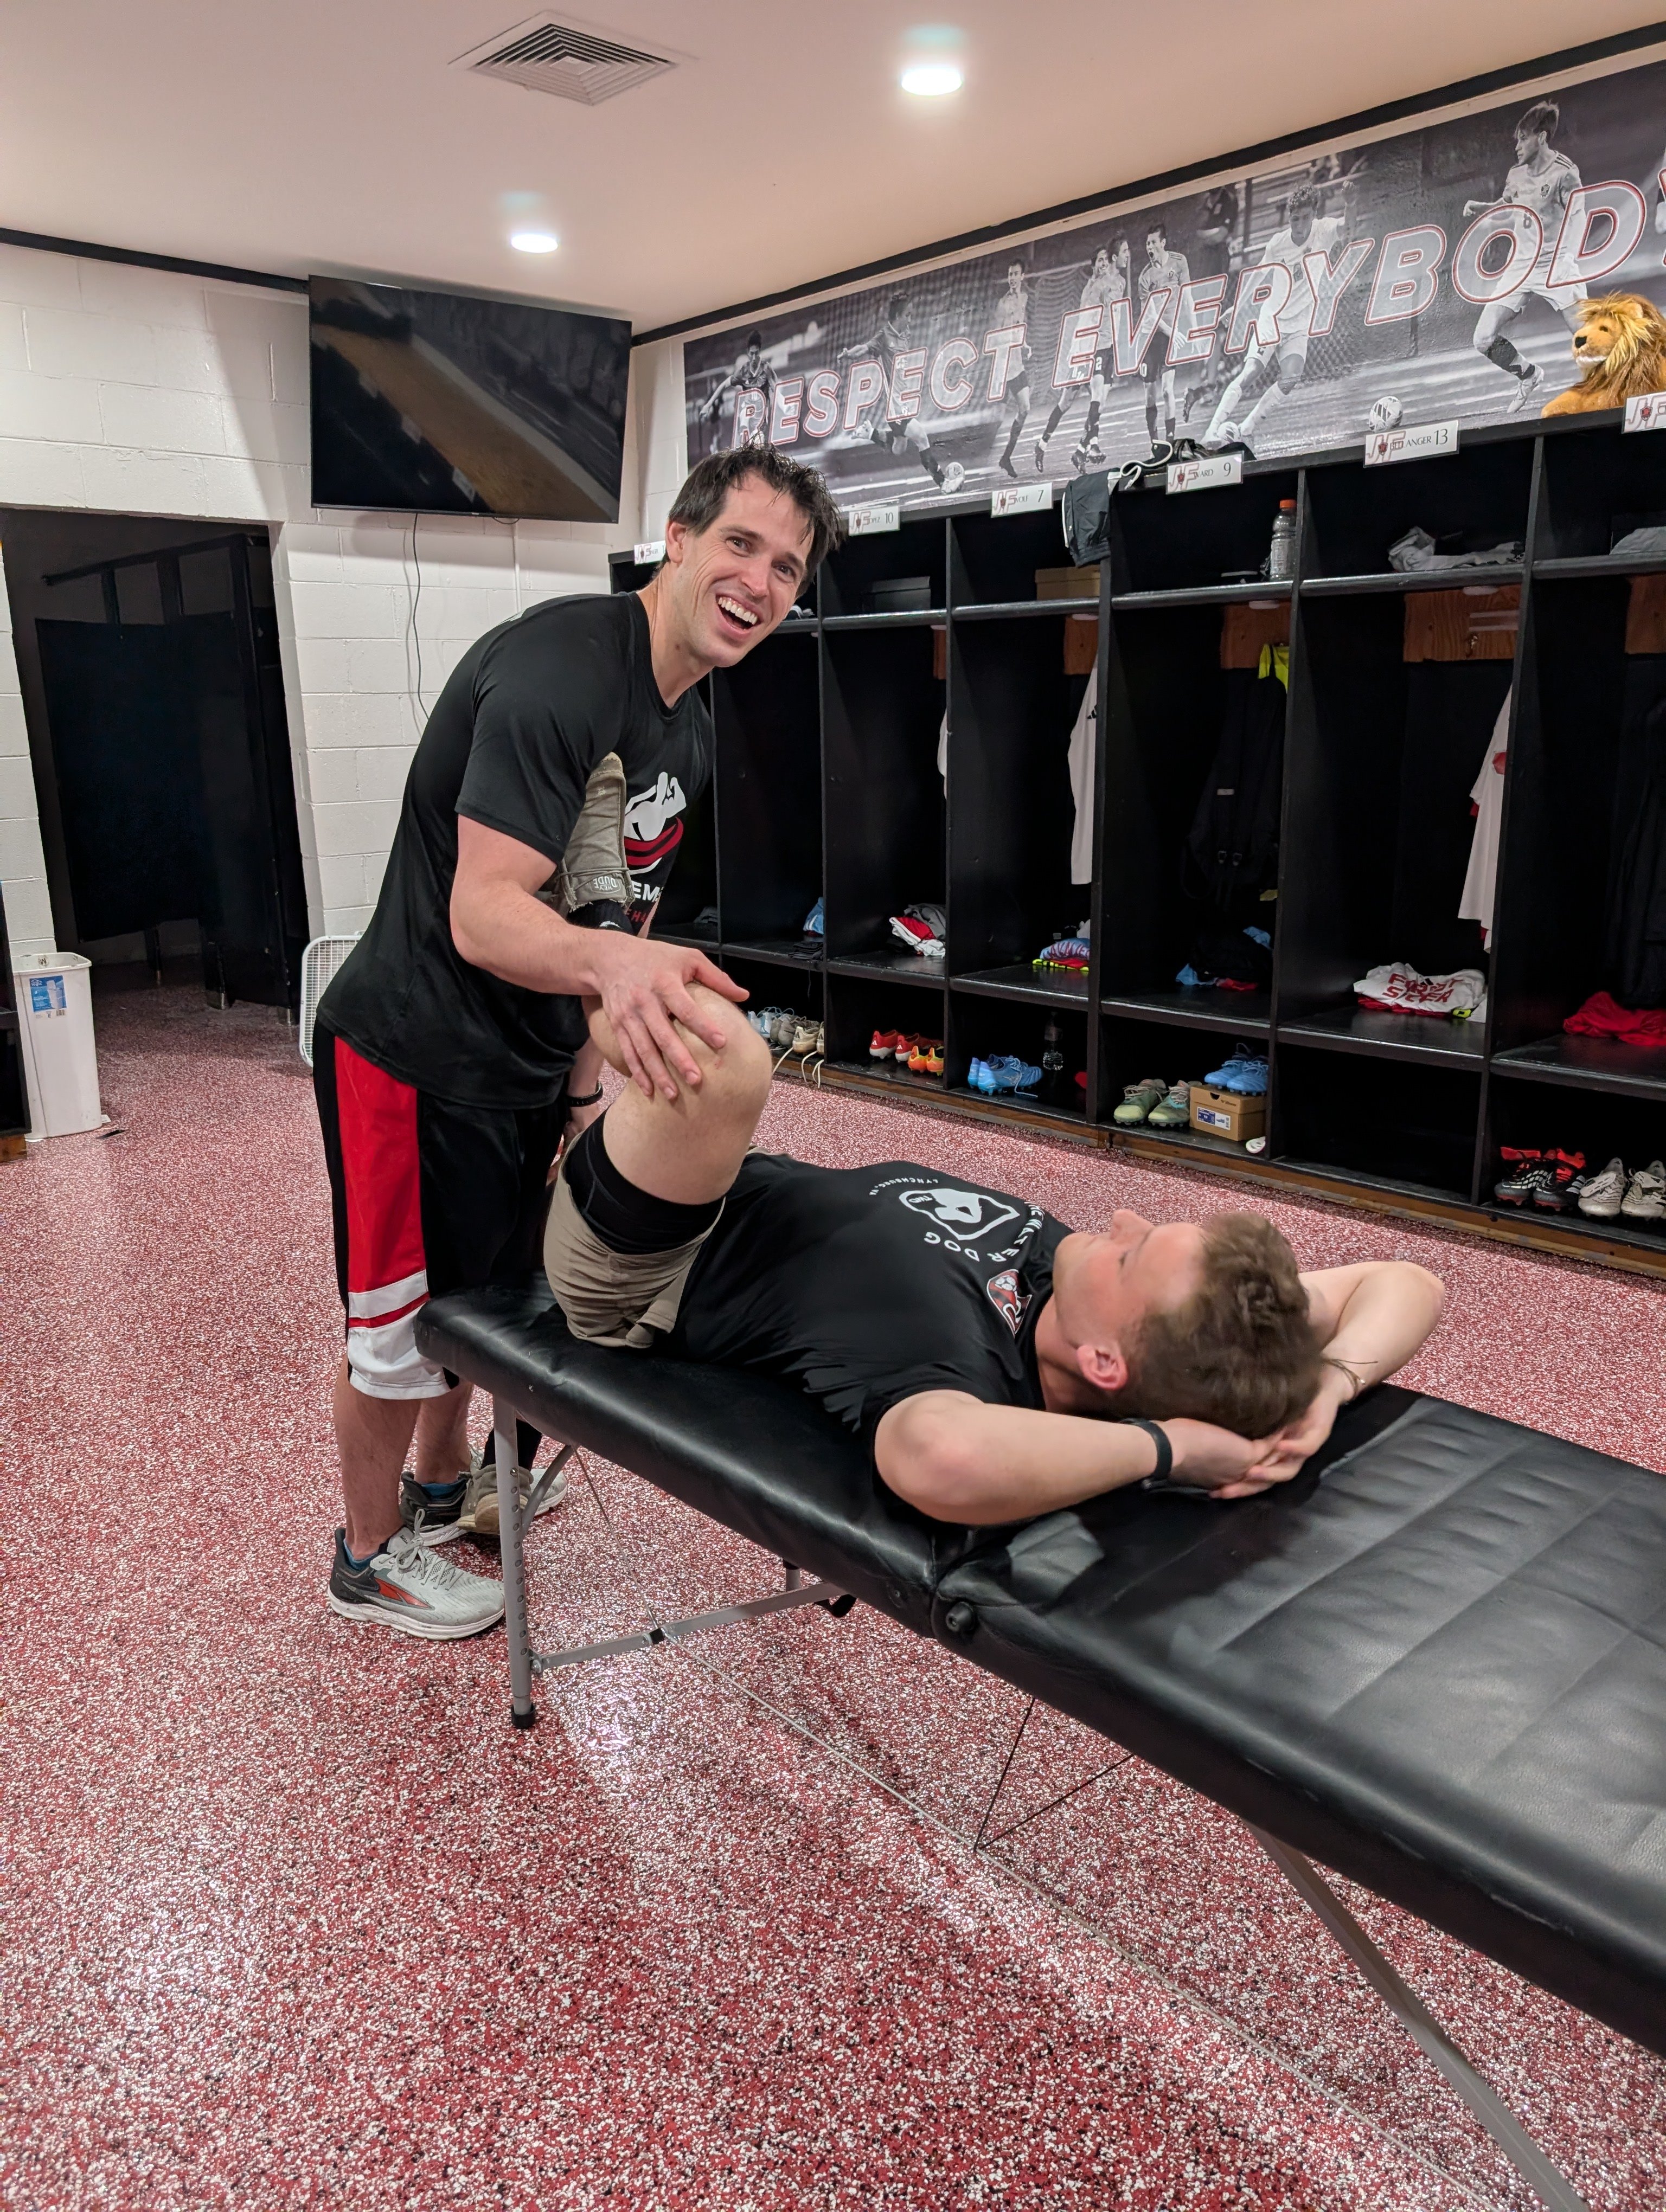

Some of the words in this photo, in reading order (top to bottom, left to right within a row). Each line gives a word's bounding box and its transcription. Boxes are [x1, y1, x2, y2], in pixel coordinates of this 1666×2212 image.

[732, 322, 1028, 451] RESPECT
[1051, 168, 1666, 389] EVERYBOD
[1434, 428, 1448, 445] 13
[1223, 462, 1231, 477] 9
[1037, 490, 1044, 503] 7
[885, 512, 894, 524] 10
[593, 876, 618, 888] DUDE
[631, 880, 664, 903] EM
[908, 1195, 933, 1204] TWO
[924, 1231, 980, 1262] DOG
